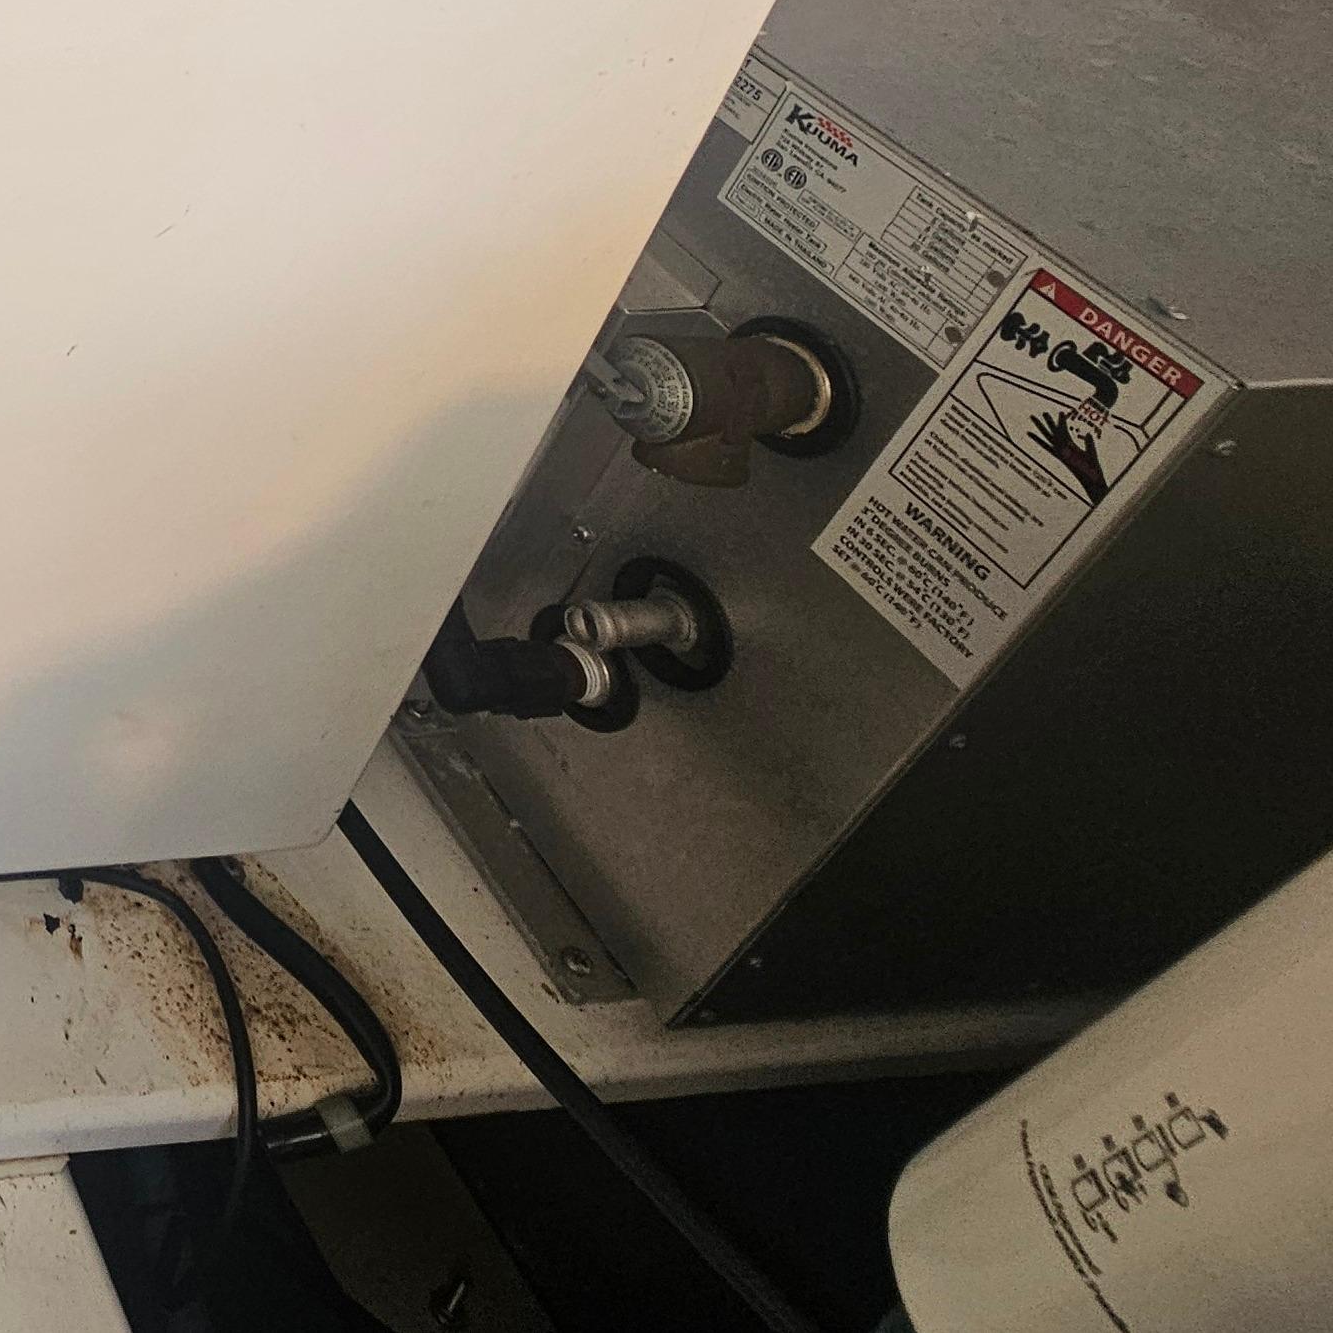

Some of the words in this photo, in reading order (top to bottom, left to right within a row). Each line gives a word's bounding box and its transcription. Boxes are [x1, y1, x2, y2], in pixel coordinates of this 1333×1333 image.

[784, 102, 867, 170] KUUMA
[1076, 305, 1184, 387] DANGER
[867, 494, 893, 519] HOT
[830, 543, 851, 563] SET
[870, 547, 897, 573] SEC.
[872, 533, 899, 558] SEC.
[902, 499, 993, 583] WARNING
[837, 534, 894, 586] CONTROLS
[921, 610, 974, 660] FACTORY
